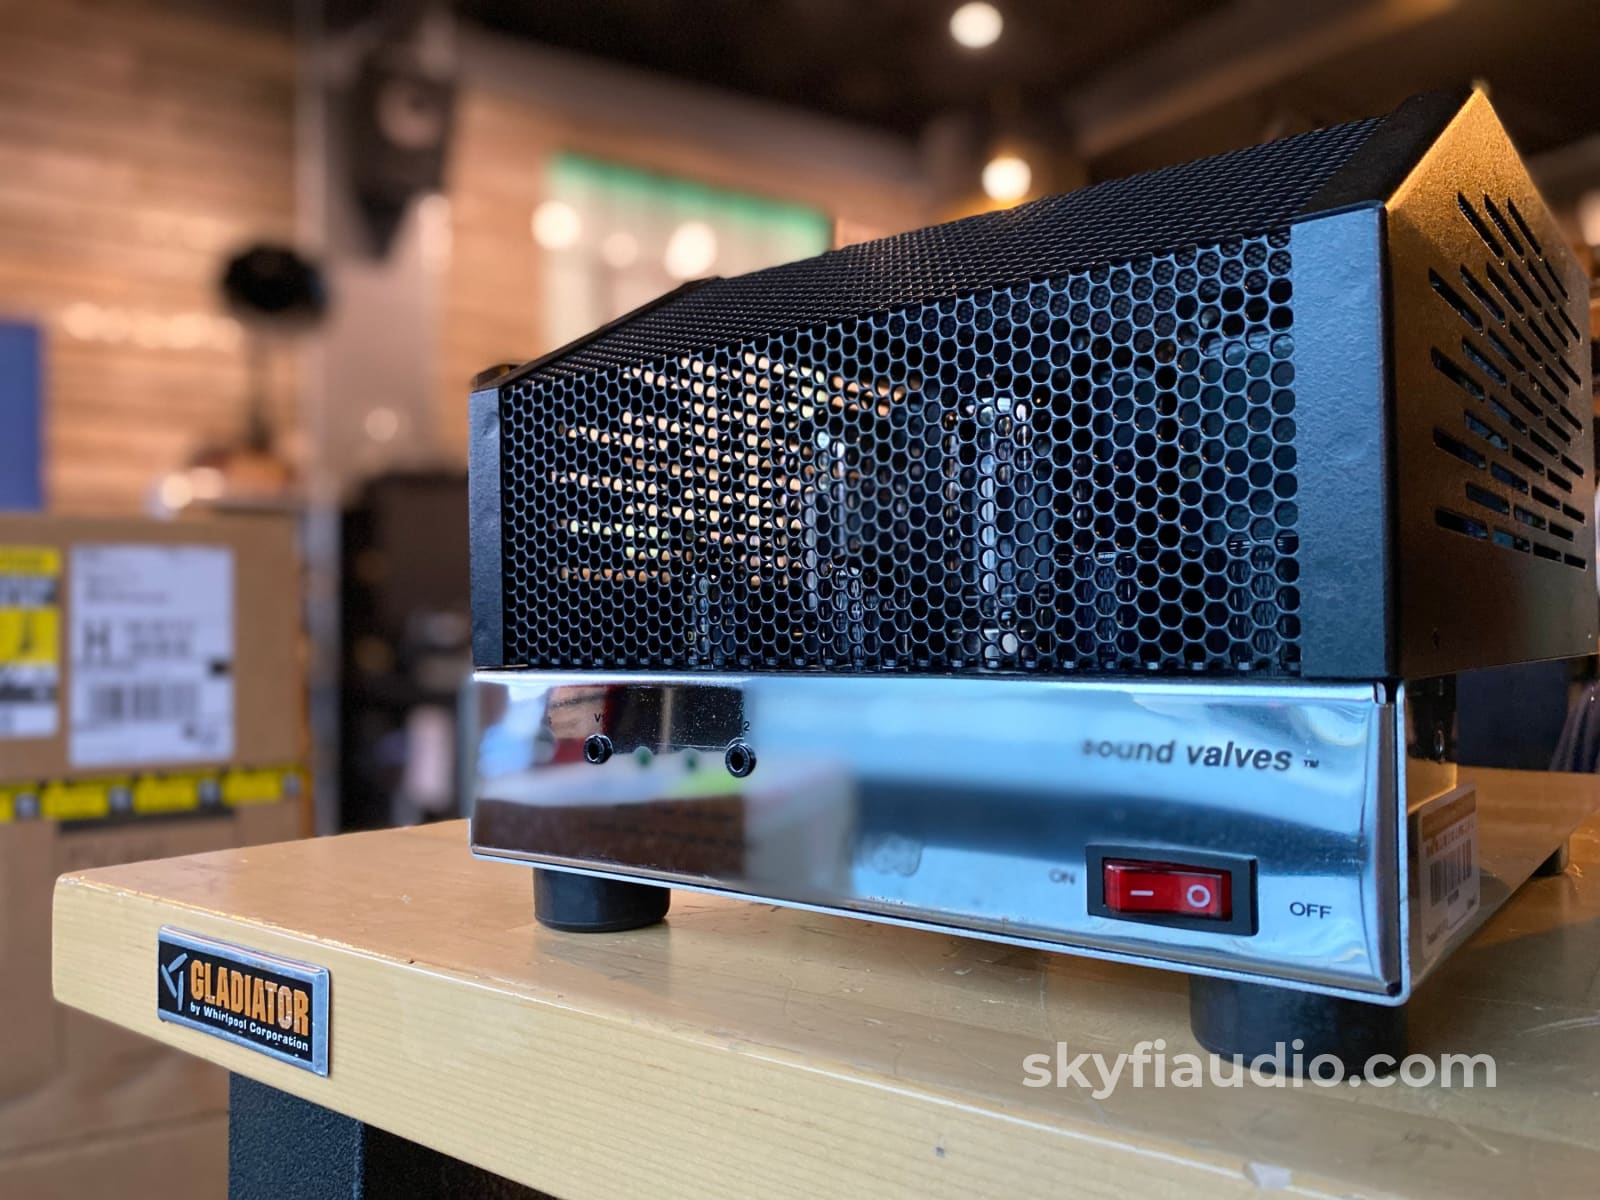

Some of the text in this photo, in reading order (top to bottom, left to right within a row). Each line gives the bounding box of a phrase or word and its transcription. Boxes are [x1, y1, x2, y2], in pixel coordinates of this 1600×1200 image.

[1080, 738, 1176, 764] sound
[1186, 740, 1293, 771] valves
[1048, 869, 1076, 885] ON
[1289, 901, 1332, 919] OFF
[190, 959, 309, 1037] GLADIATOR
[190, 1001, 309, 1052] by Whirlpool Corporation
